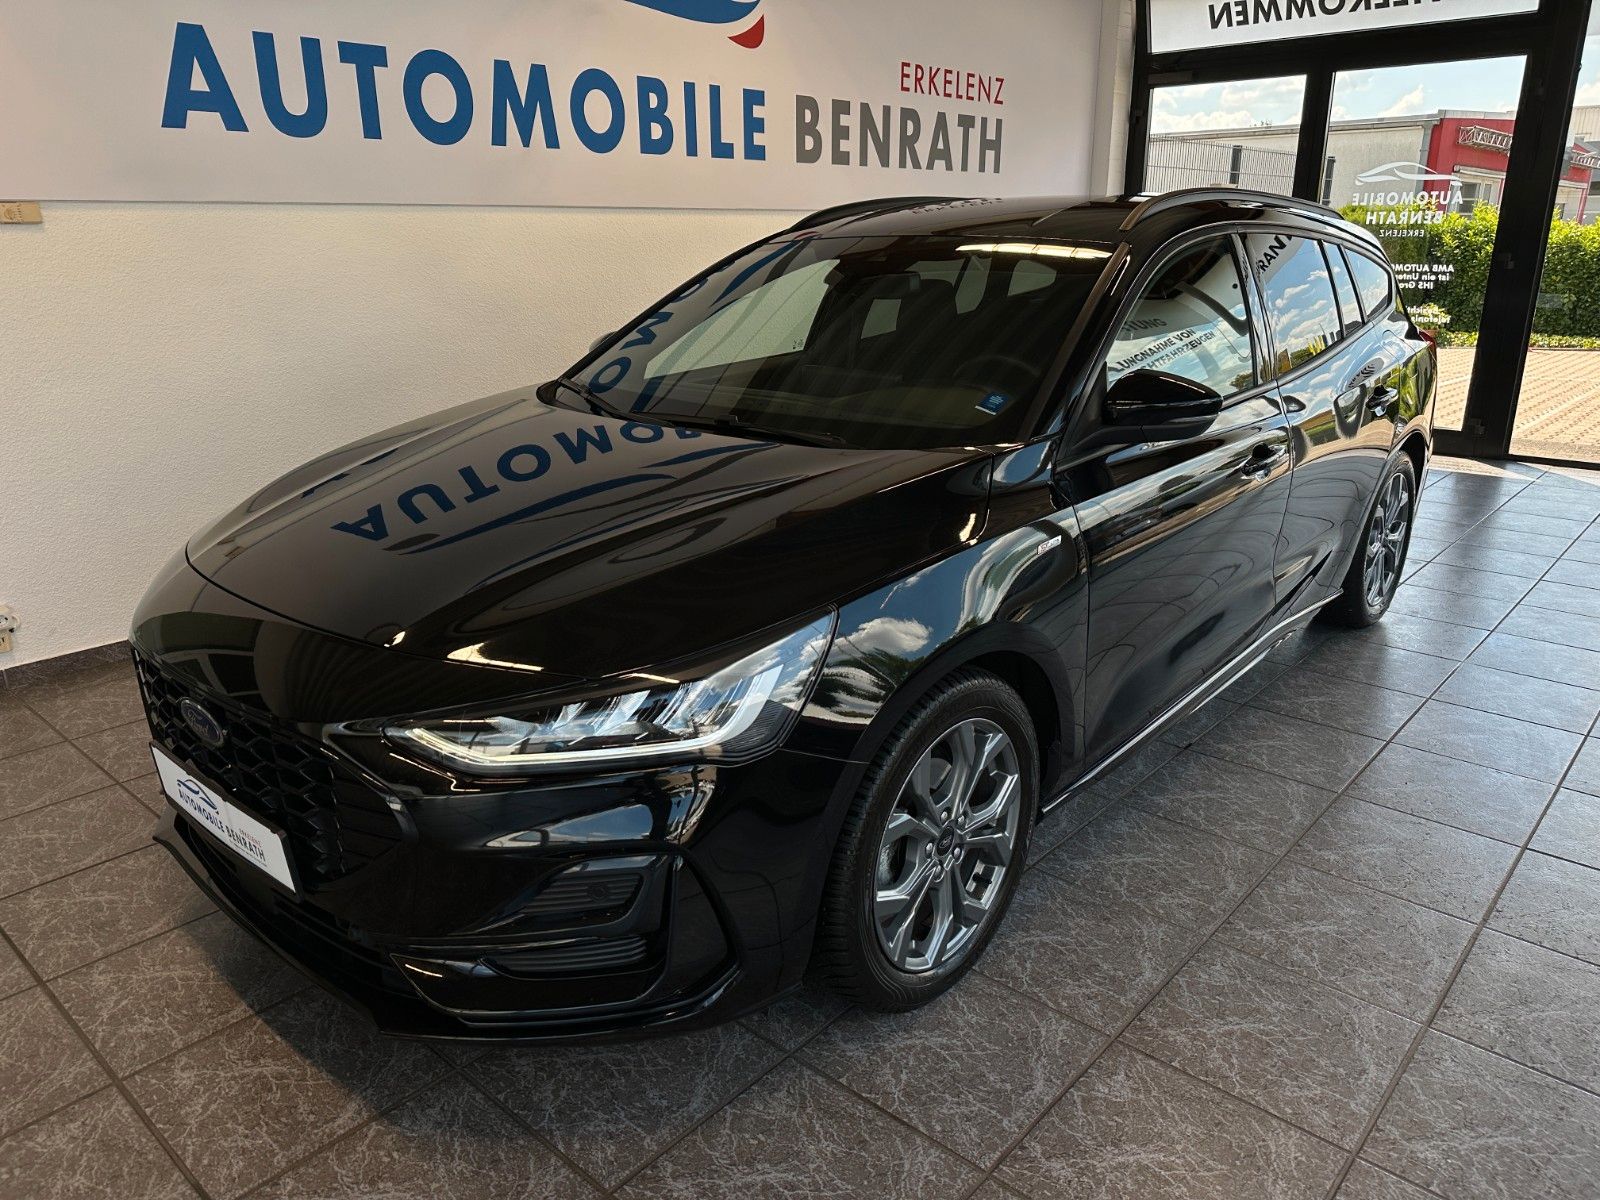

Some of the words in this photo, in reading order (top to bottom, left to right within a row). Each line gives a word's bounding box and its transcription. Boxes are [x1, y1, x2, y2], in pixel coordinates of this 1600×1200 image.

[161, 21, 767, 162] AUTOMOBILE
[795, 94, 1003, 174] BENRATH
[900, 61, 1005, 105] ERKELENZ
[1173, 328, 1196, 344] VON
